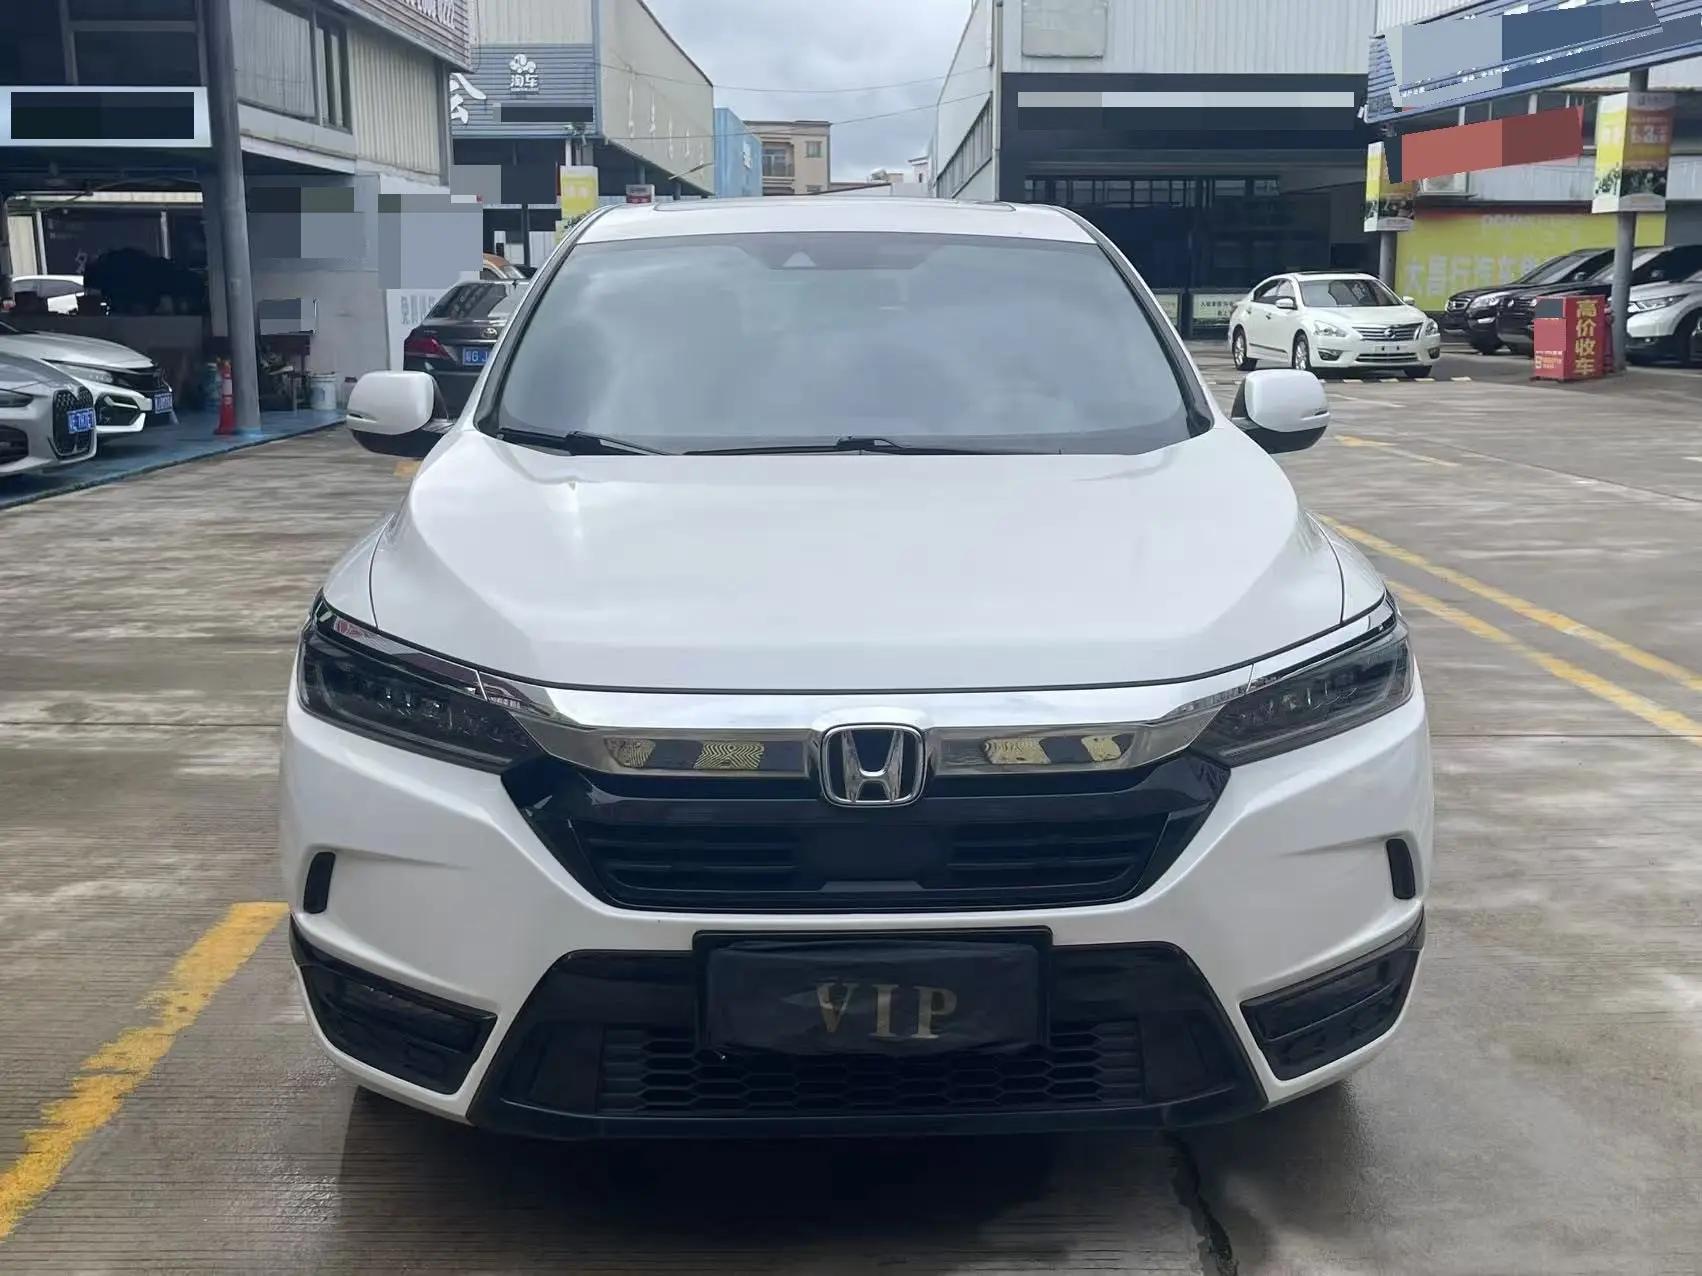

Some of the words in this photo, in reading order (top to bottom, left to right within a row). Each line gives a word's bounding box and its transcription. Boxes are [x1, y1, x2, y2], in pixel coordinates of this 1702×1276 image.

[510, 74, 538, 88] 淘车
[1575, 299, 1598, 376] 高价收车
[816, 982, 958, 1039] VIP
